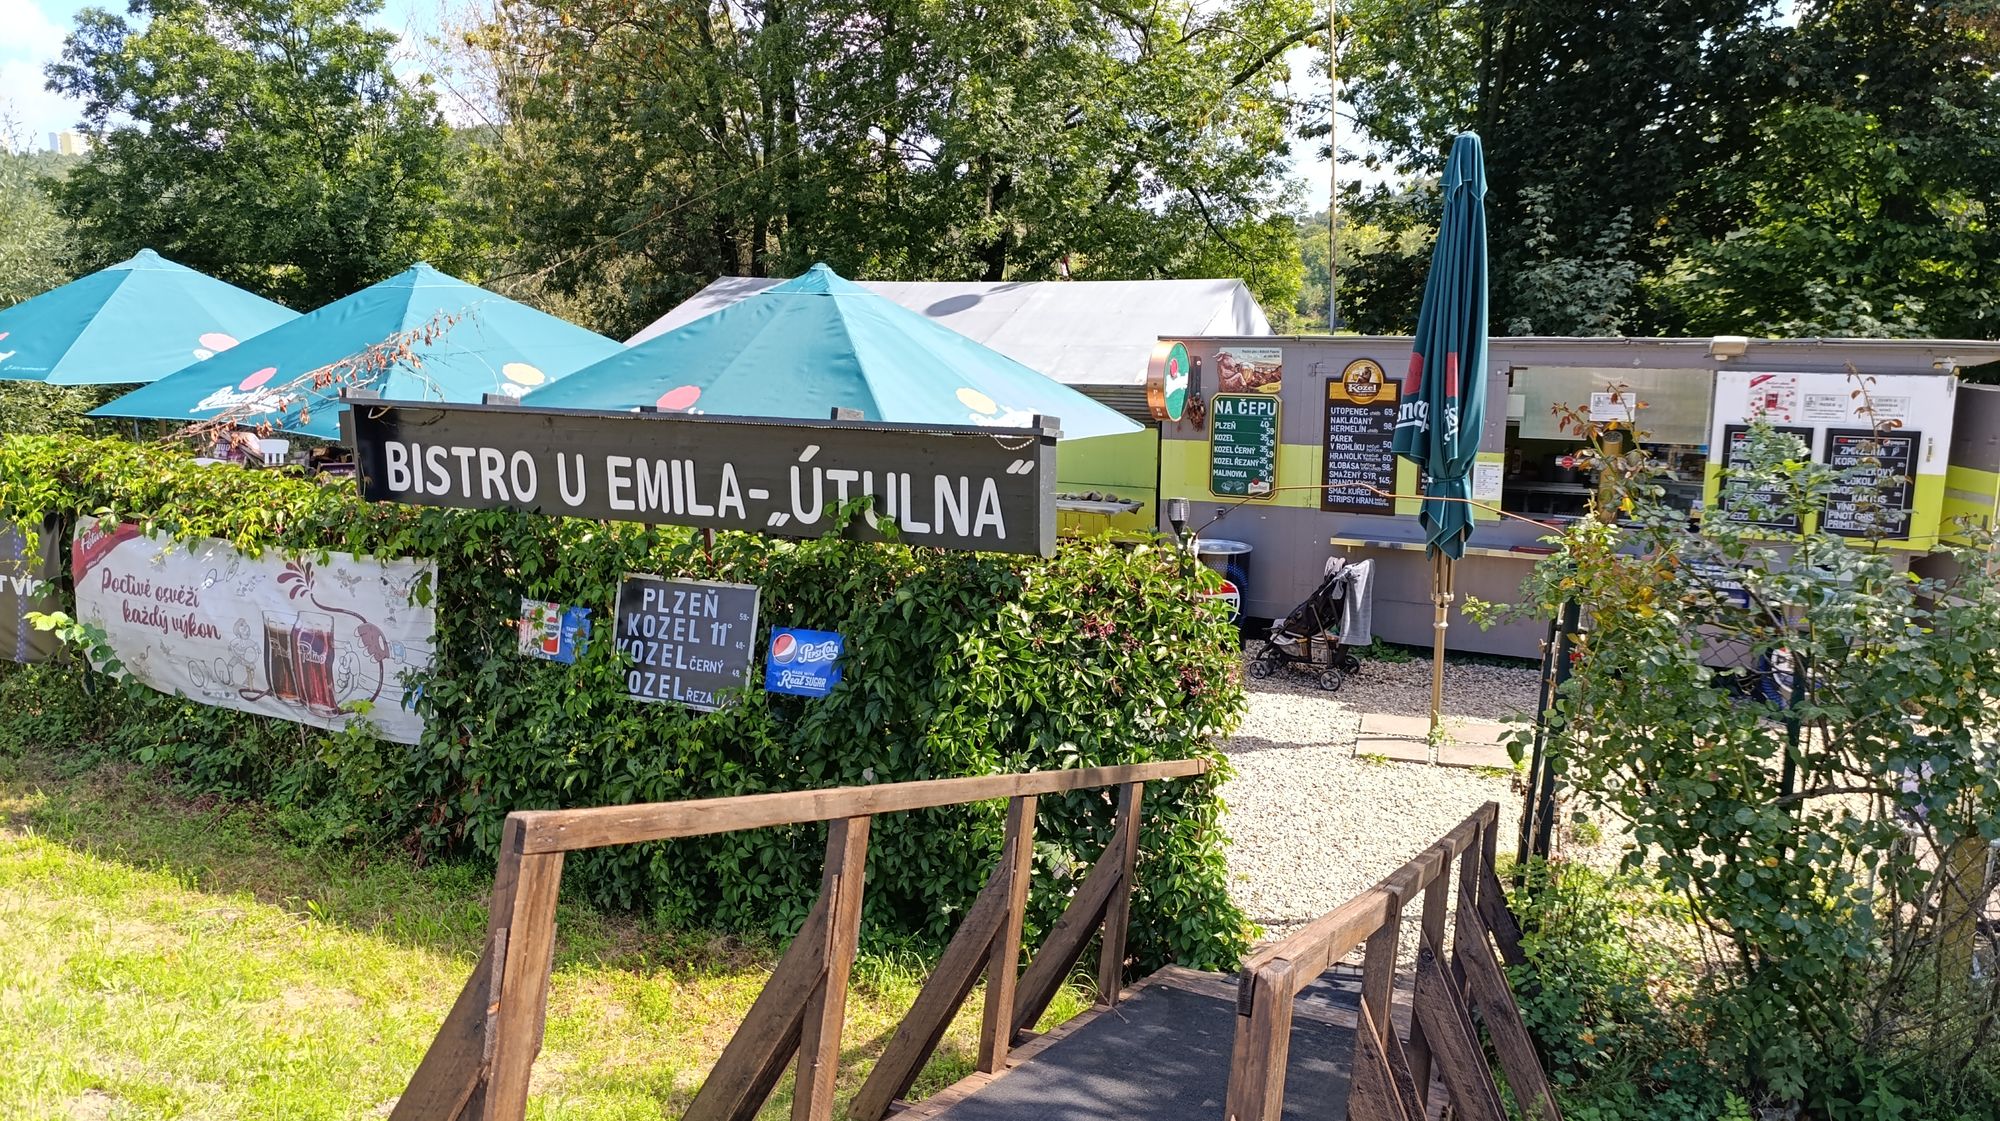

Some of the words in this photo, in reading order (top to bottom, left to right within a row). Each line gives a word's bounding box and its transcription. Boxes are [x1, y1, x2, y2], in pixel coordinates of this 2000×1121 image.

[1348, 383, 1377, 393] Kozel
[1215, 400, 1233, 414] NA
[1238, 398, 1276, 416] ČEPU
[1330, 407, 1369, 415] UTOPENEC
[1215, 420, 1236, 430] PLZEŇ
[1260, 420, 1270, 428] 40
[1330, 416, 1373, 425] NAKLÁDANÝ
[1330, 424, 1367, 433] HERMELÍN
[1214, 433, 1234, 442] KOZEL
[1260, 433, 1268, 441] 35
[1330, 434, 1353, 443] PÁREK
[1214, 445, 1234, 454] KOZEL
[1234, 445, 1256, 455] ČERNÝ
[1260, 445, 1268, 453] 35
[1330, 442, 1335, 450] V
[1336, 443, 1365, 451] ROHLÍKU
[1329, 452, 1366, 461] HRANOLKY
[1213, 457, 1233, 466] KOZEL
[1234, 457, 1259, 467] ŘEZANÝ
[1329, 461, 1360, 470] KLOBÁSA
[384, 440, 538, 502] BISTRO
[557, 452, 587, 506] U
[1213, 469, 1247, 478] MALINOVKA
[1259, 469, 1268, 477] 30
[1329, 470, 1362, 479] SMAŽENÝ
[1363, 471, 1377, 480] SÝR
[1328, 495, 1356, 504] STRIPSY
[1828, 511, 1853, 520] PINOT
[101, 567, 151, 597] Poctivě
[155, 584, 199, 608] osvěží
[642, 587, 719, 618] PLZEŇ
[122, 599, 168, 635] každý
[172, 612, 221, 640] výkon
[627, 612, 700, 644] KOZEL
[616, 638, 688, 670] KOZEL
[689, 655, 724, 674] ČERNÝ
[622, 669, 685, 701] OZEL
